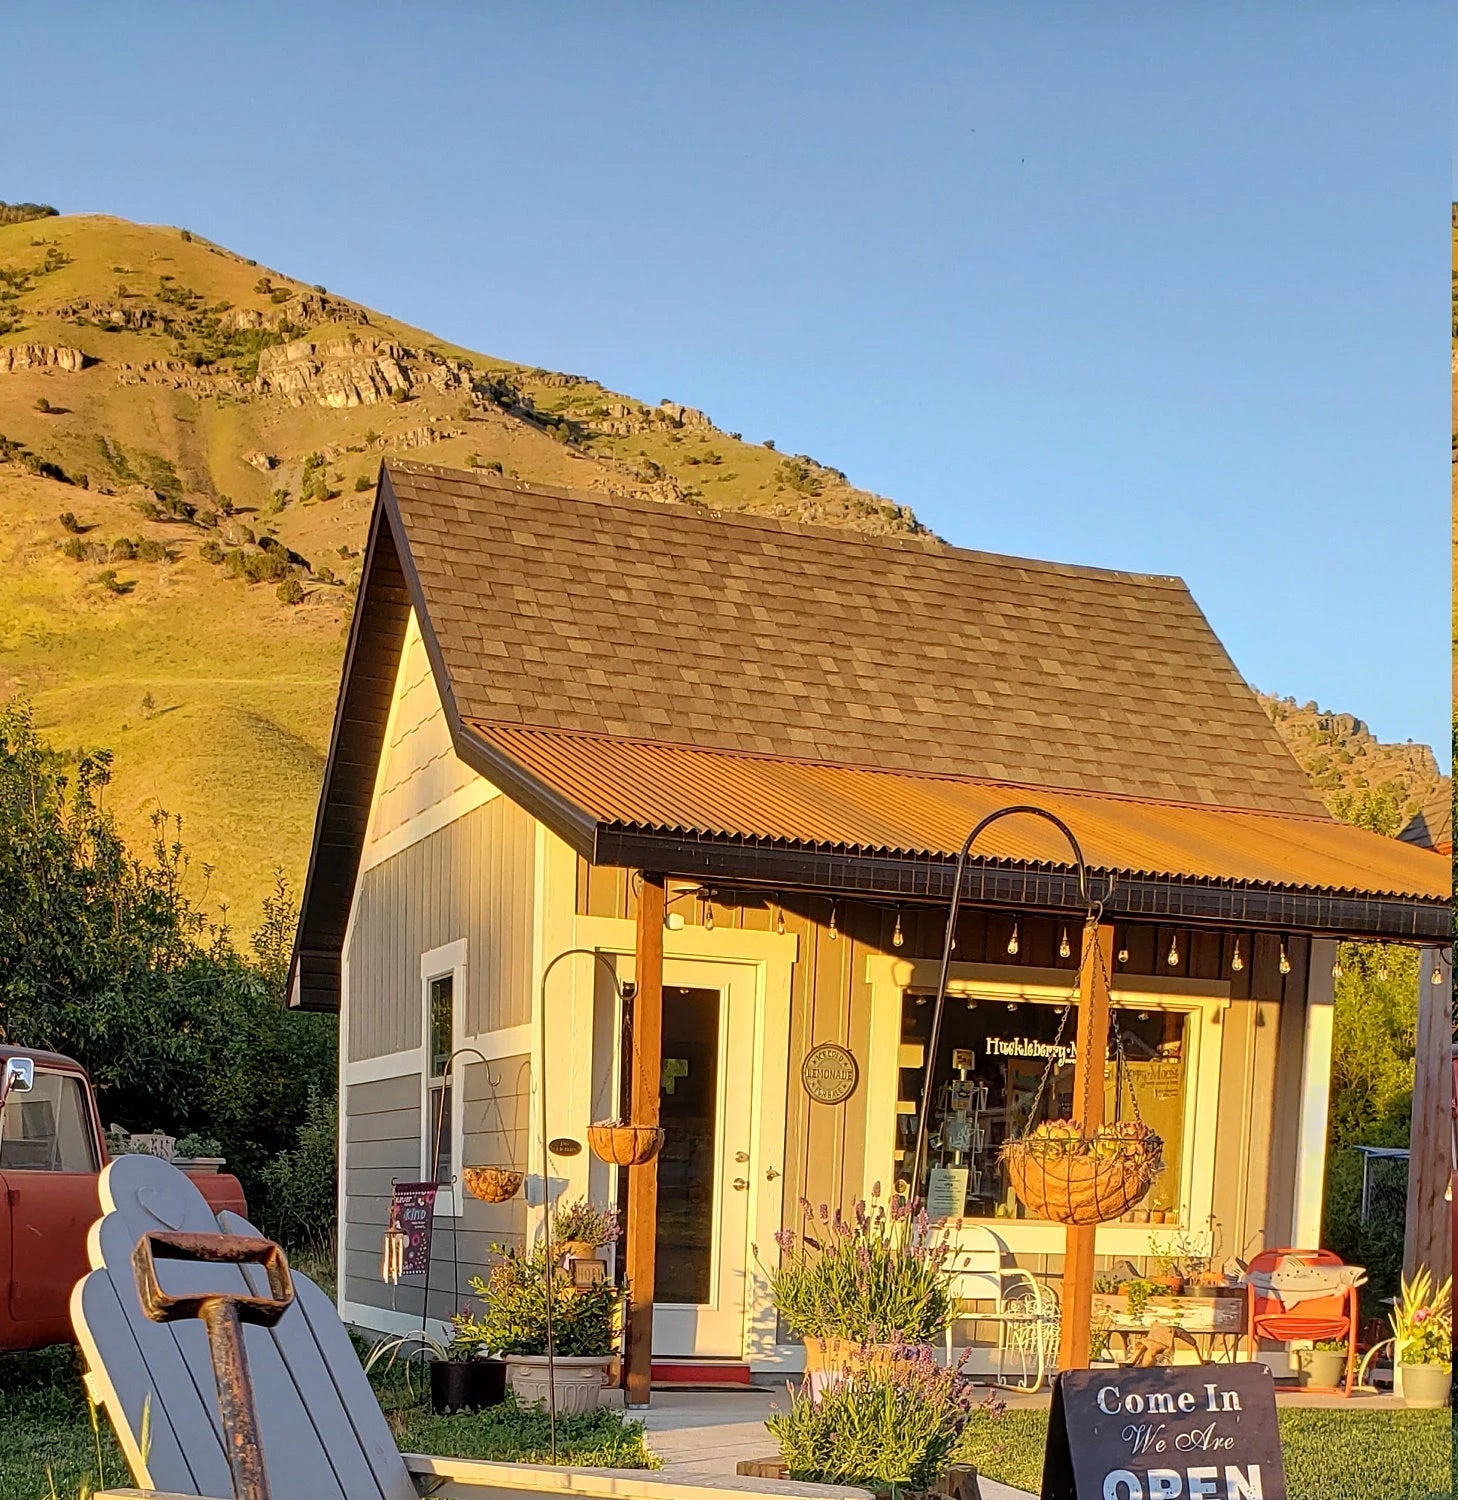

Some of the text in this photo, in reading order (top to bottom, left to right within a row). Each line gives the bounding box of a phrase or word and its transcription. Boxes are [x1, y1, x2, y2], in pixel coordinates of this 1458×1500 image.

[806, 1068, 852, 1080] LEMONADE
[1097, 1383, 1243, 1415] Come In
[1121, 1422, 1235, 1455] We Are
